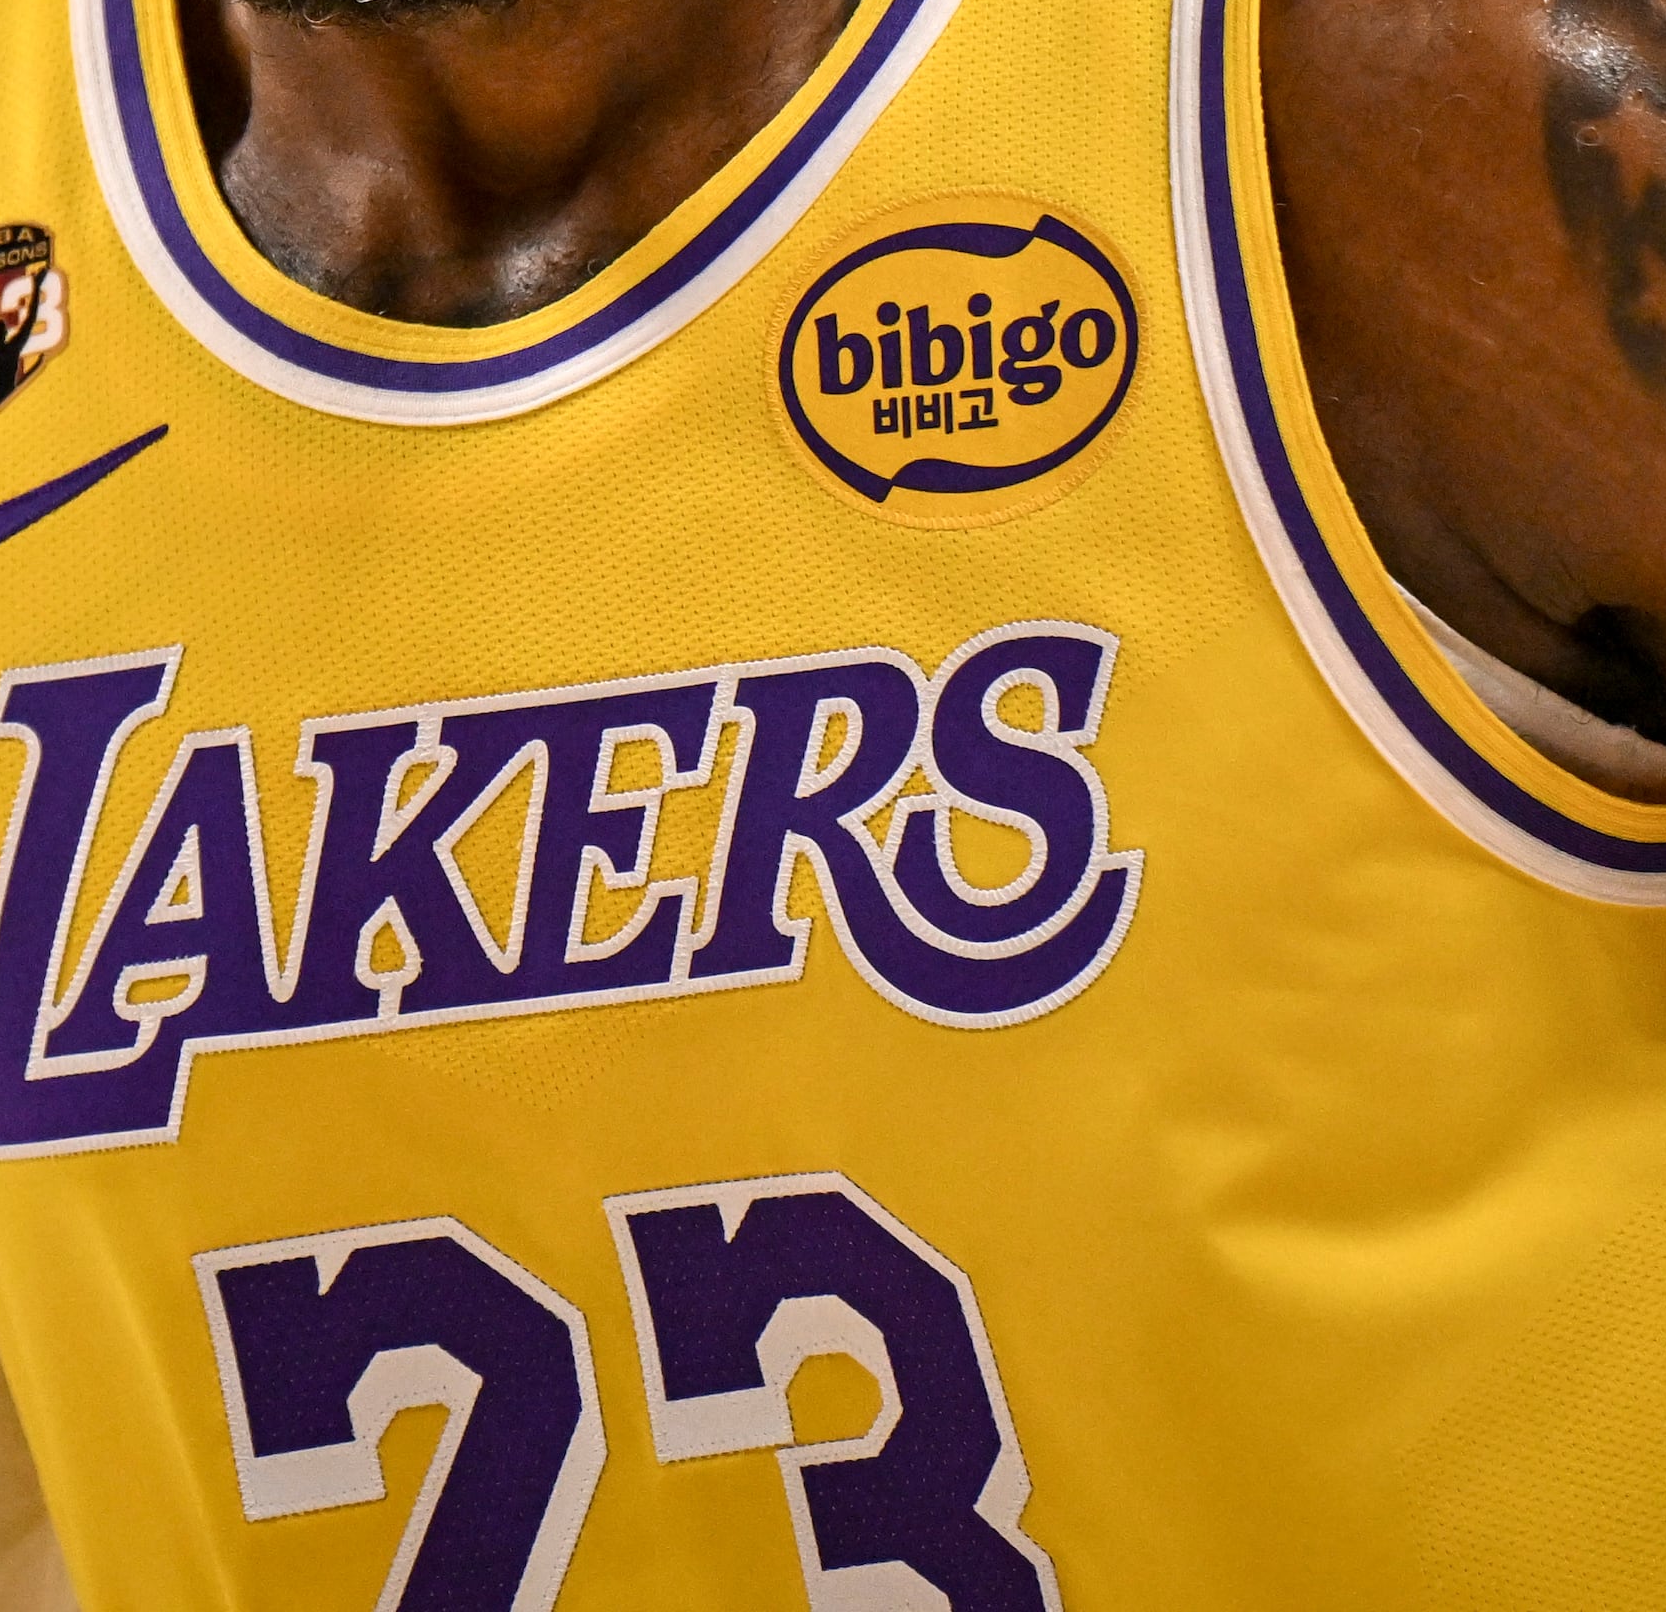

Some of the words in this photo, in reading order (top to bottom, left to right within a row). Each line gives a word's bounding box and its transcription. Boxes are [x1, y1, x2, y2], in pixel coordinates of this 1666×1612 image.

[814, 292, 1117, 406] bibigo
[872, 387, 999, 439] 비비고
[192, 1171, 1064, 1612] 23
